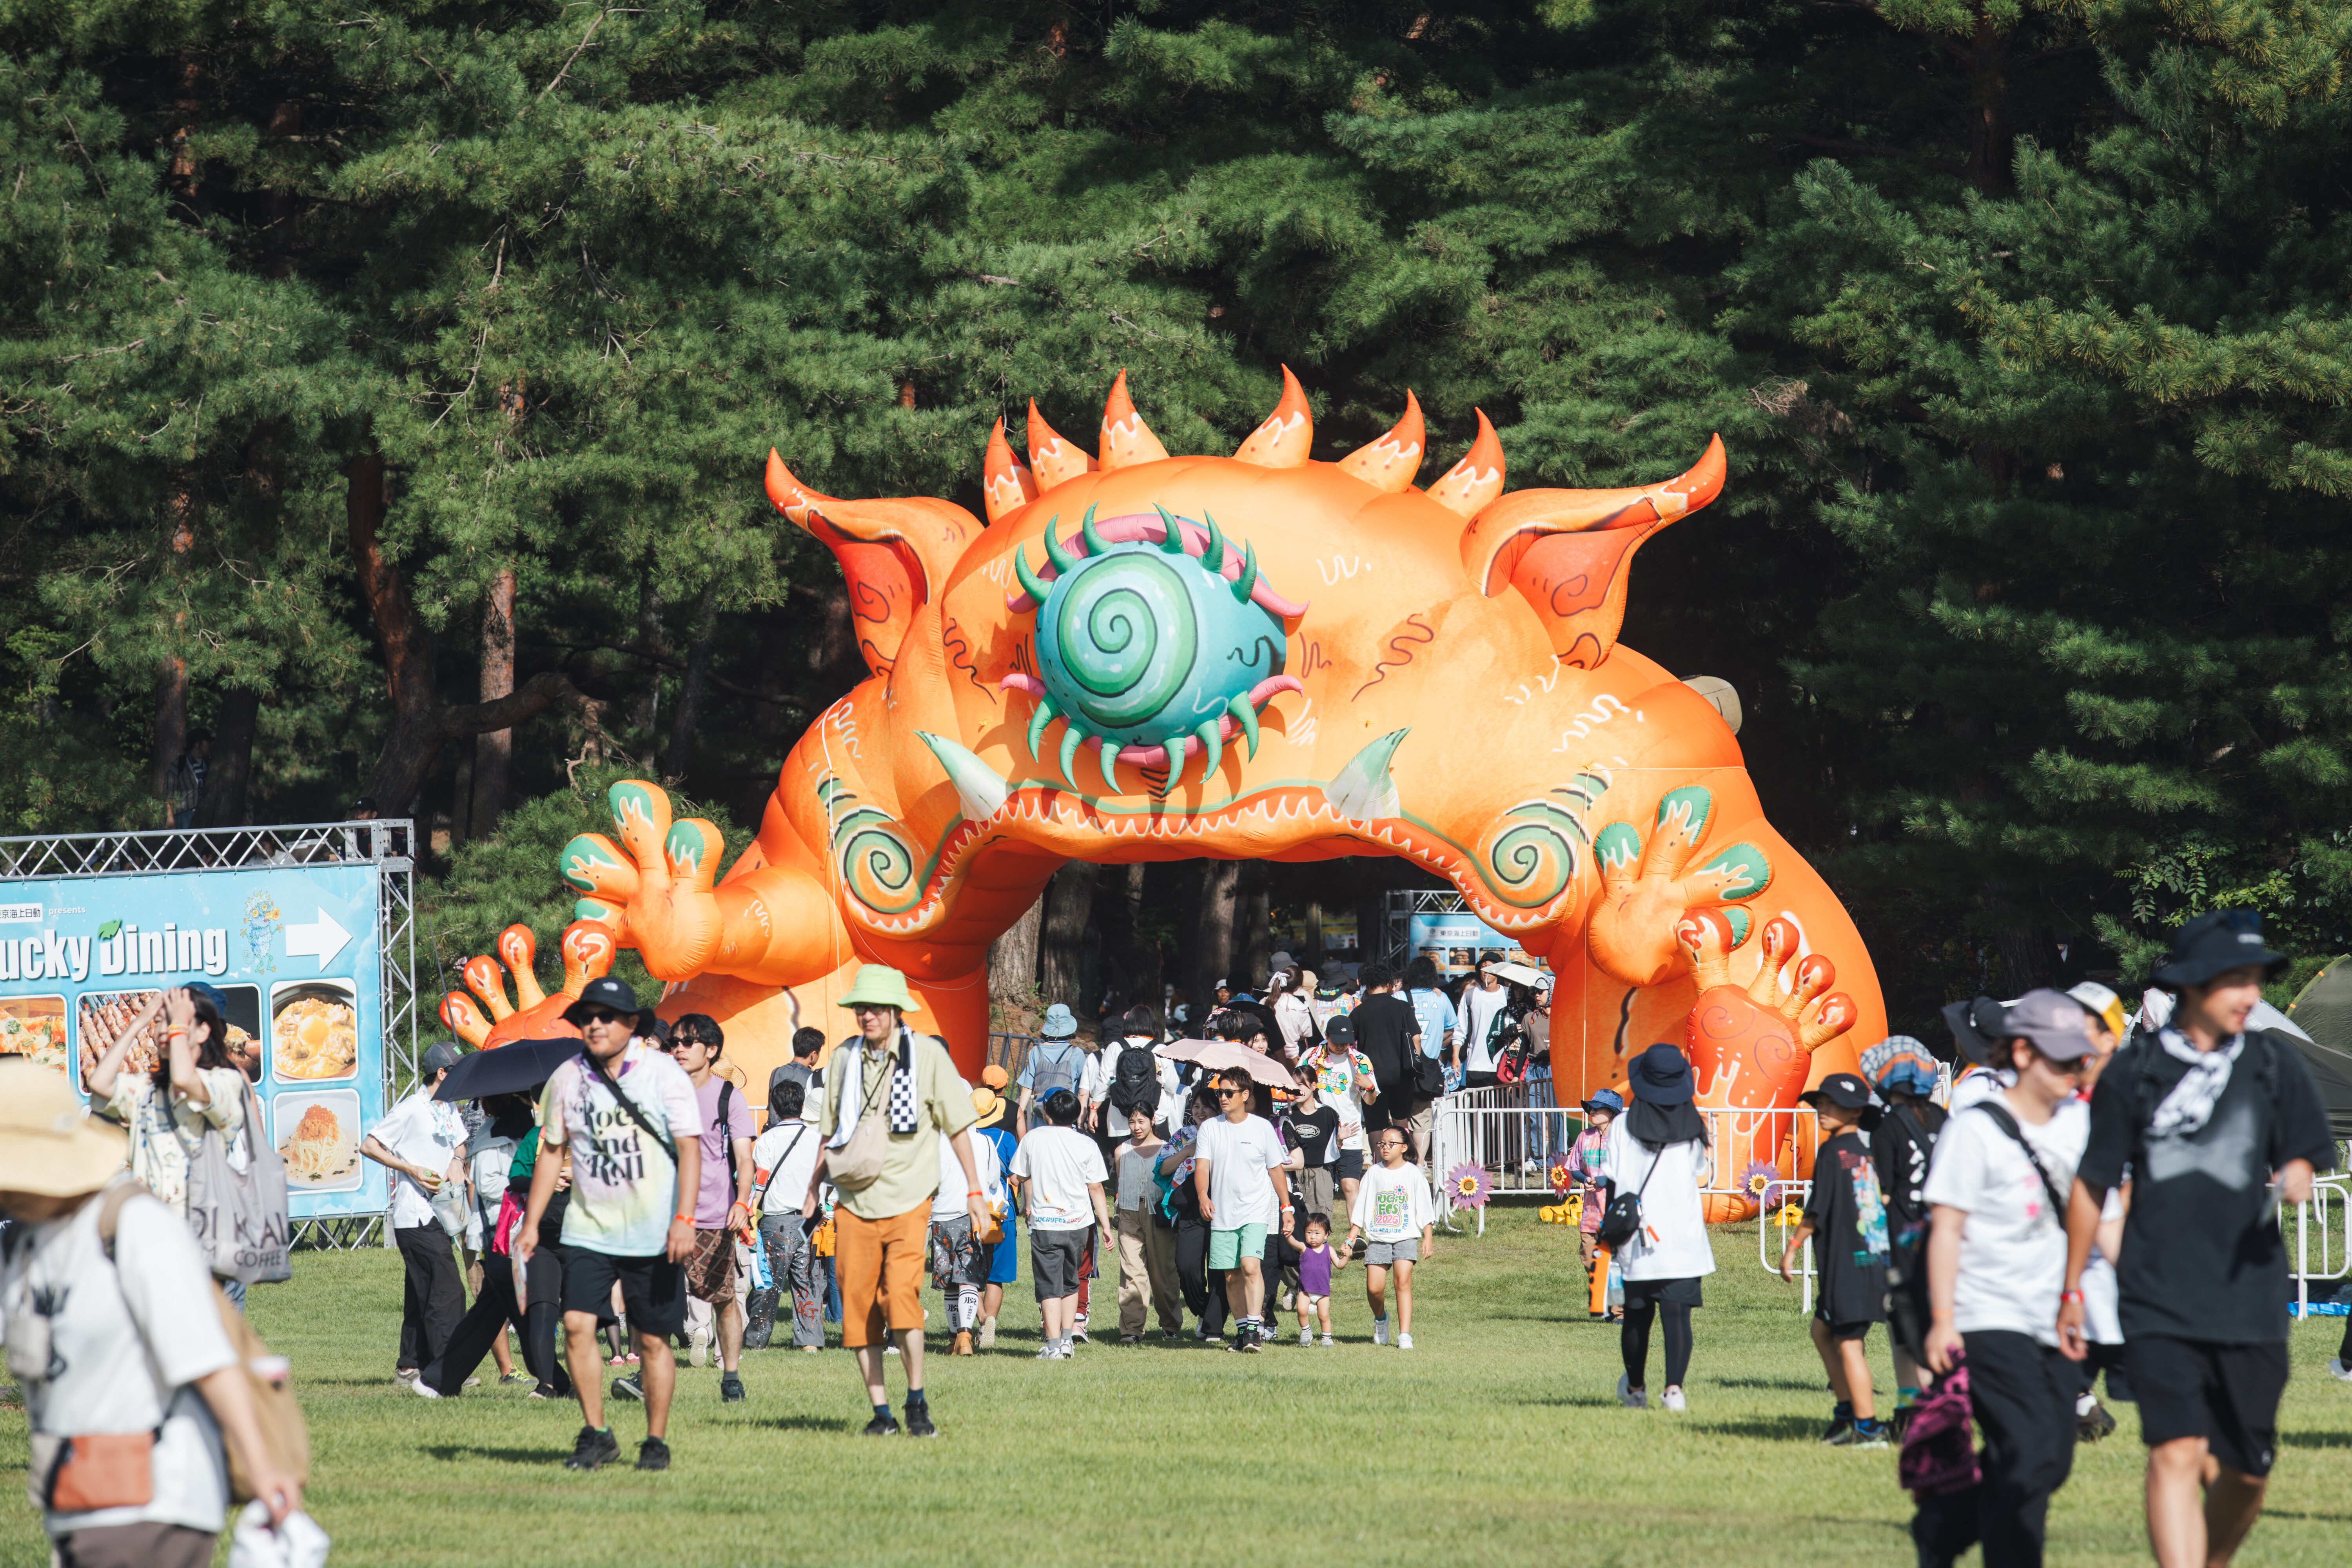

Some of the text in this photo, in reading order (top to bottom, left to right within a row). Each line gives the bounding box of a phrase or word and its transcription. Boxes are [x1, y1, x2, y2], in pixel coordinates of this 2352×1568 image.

[0, 906, 86, 919] 京海上日動 presents
[100, 923, 227, 975] Dining
[1337, 998, 1348, 1007] FES
[574, 1101, 628, 1136] Roc
[1377, 1215, 1398, 1224] 2026
[234, 1250, 281, 1267] COFFEE
[963, 1297, 976, 1306] 脱
